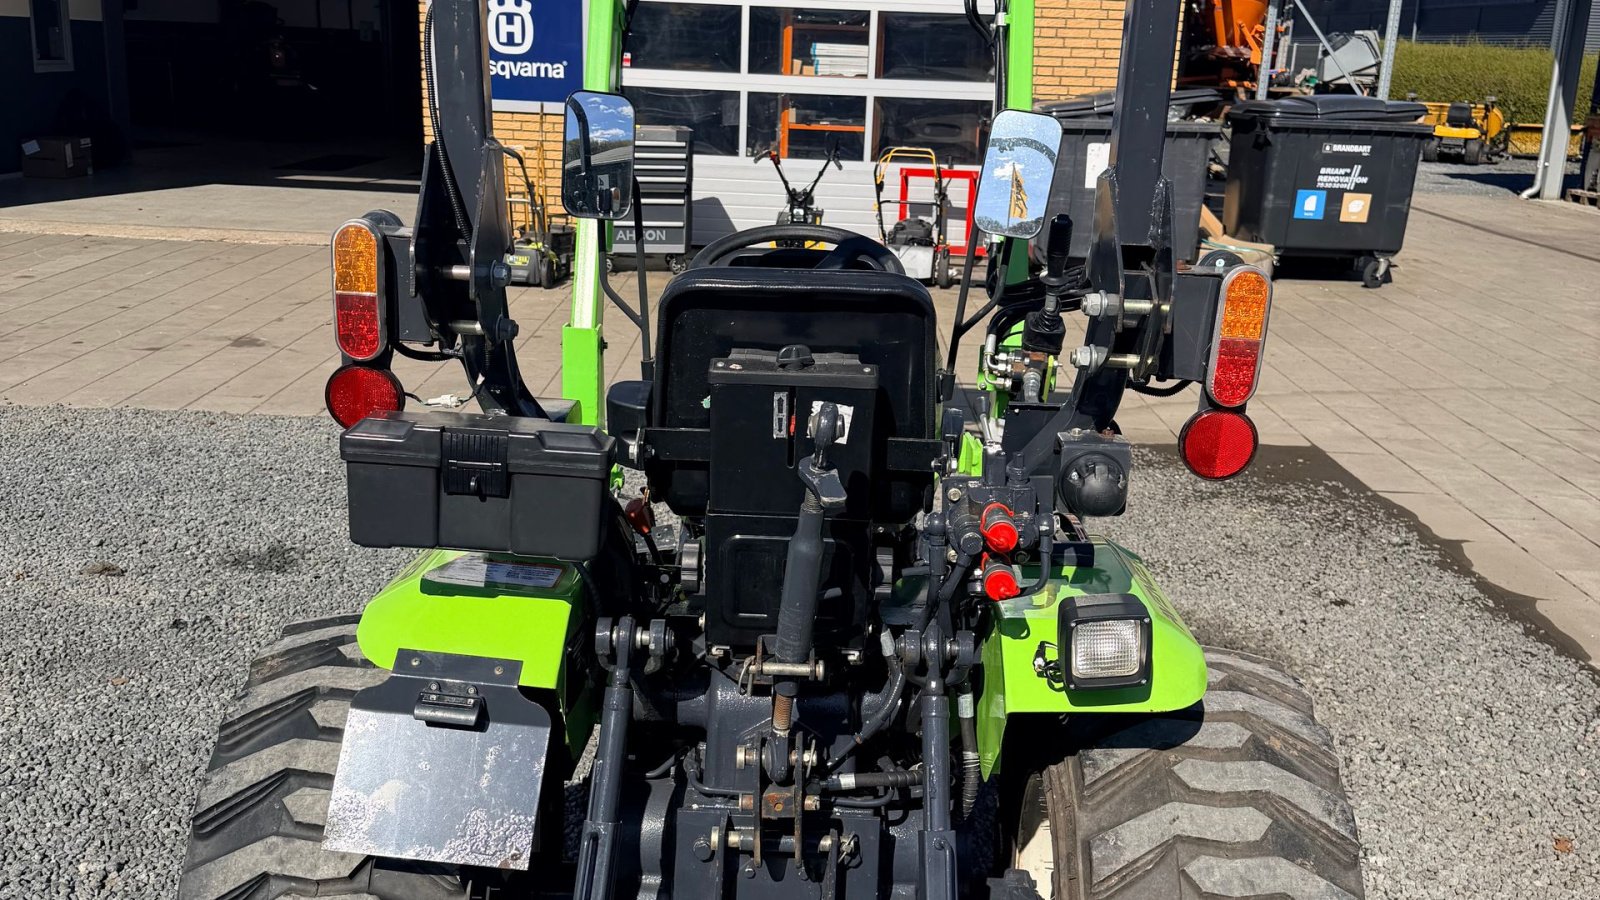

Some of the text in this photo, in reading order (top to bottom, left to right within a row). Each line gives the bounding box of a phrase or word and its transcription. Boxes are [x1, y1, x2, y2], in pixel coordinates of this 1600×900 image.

[498, 14, 523, 44] H
[489, 60, 565, 80] sqvarna
[616, 229, 666, 241] AHON
